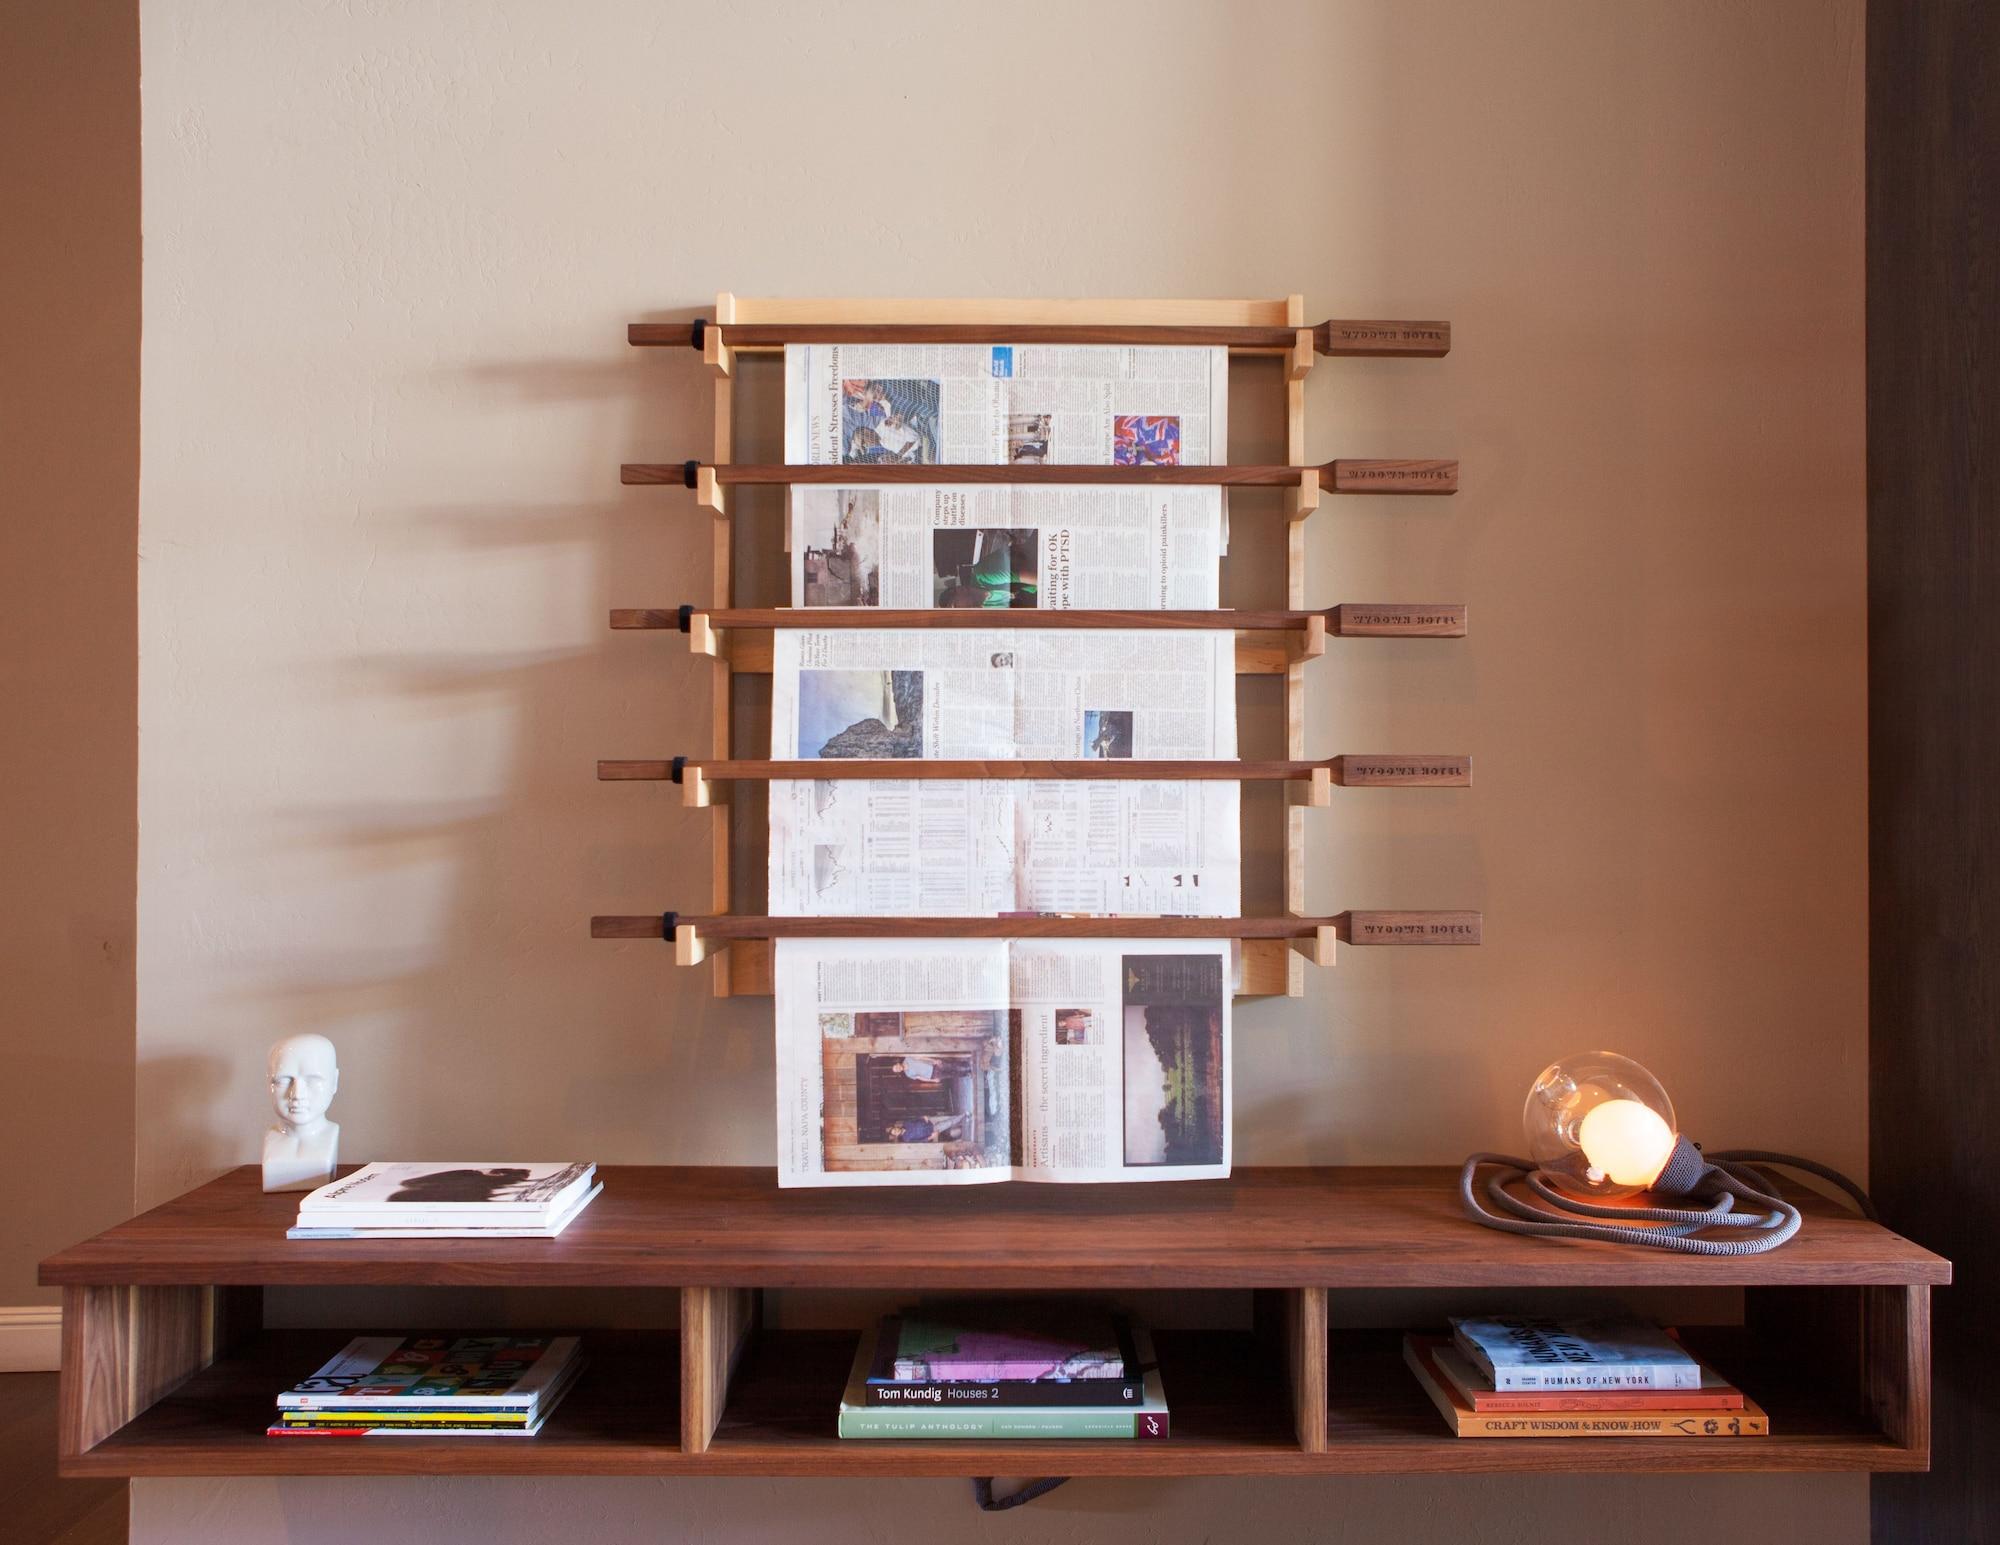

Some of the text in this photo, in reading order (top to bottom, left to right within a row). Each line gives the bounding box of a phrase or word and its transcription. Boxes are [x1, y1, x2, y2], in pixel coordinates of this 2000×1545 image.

[828, 346, 840, 391] Freedoms
[828, 393, 840, 433] Stresses
[933, 489, 942, 526] Company
[944, 494, 950, 504] up
[952, 492, 957, 503] on
[1160, 503, 1169, 546] painkillers
[1048, 534, 1057, 551] OK
[1060, 529, 1070, 562] PTSD
[1047, 554, 1057, 570] for
[1160, 548, 1168, 574] opioid
[1060, 566, 1069, 590] with
[1160, 575, 1167, 583] to
[1431, 925, 1472, 934] HOTEL
[1038, 1015, 1049, 1064] ingredient
[1039, 1066, 1048, 1095] secret
[1039, 1096, 1048, 1112] the
[800, 1077, 809, 1173] TRAVEL NAPA COUNTY
[1040, 1126, 1048, 1168] Artisans
[1544, 1377, 1581, 1385] HUMANS
[1586, 1377, 1597, 1385] OF
[1626, 1376, 1650, 1384] YORK
[877, 1387, 999, 1401] Tom Kundig Houses 2
[1485, 1421, 1662, 1430] CRAFT WISDOM & KNOW-HOW
